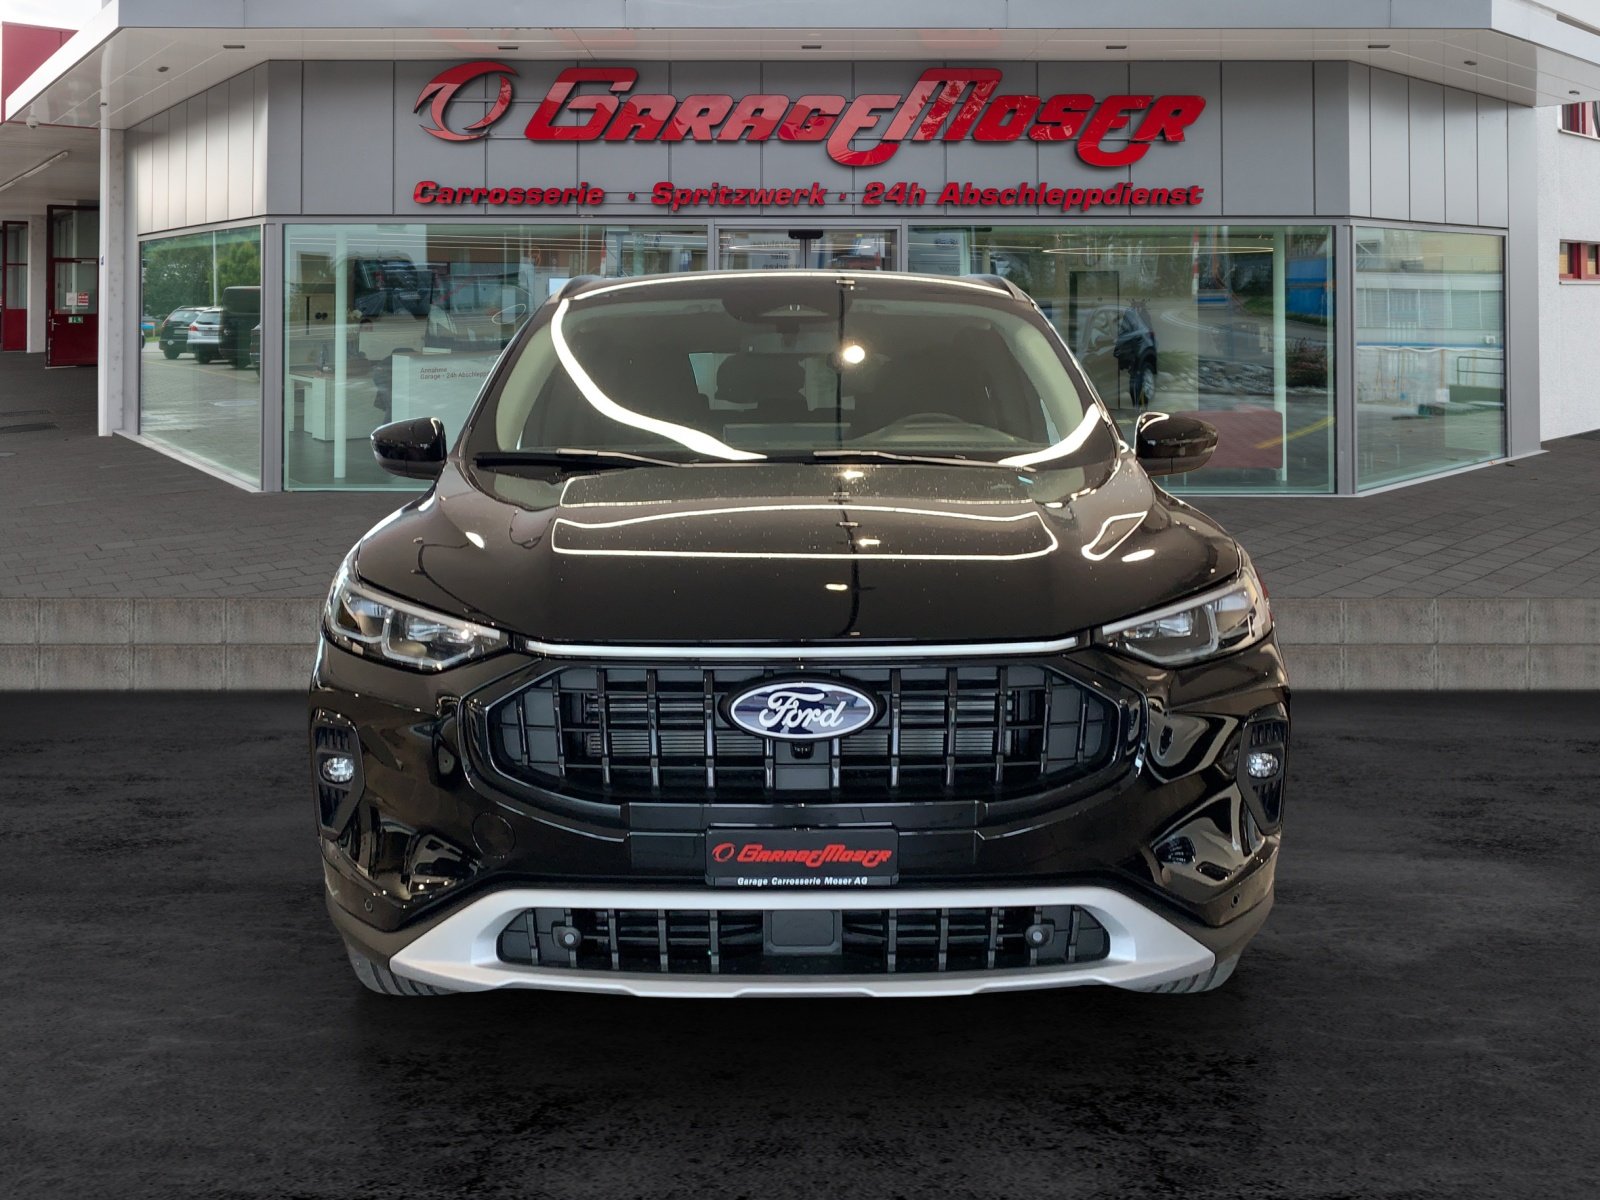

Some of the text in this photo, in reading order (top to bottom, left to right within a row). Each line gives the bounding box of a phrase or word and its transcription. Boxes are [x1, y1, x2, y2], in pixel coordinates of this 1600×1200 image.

[413, 180, 1204, 211] Carrosserie Spritzwerk 24h Abschleppdienst
[758, 691, 846, 728] Ford
[737, 877, 868, 887] Garage Carrosserie Moser AG
